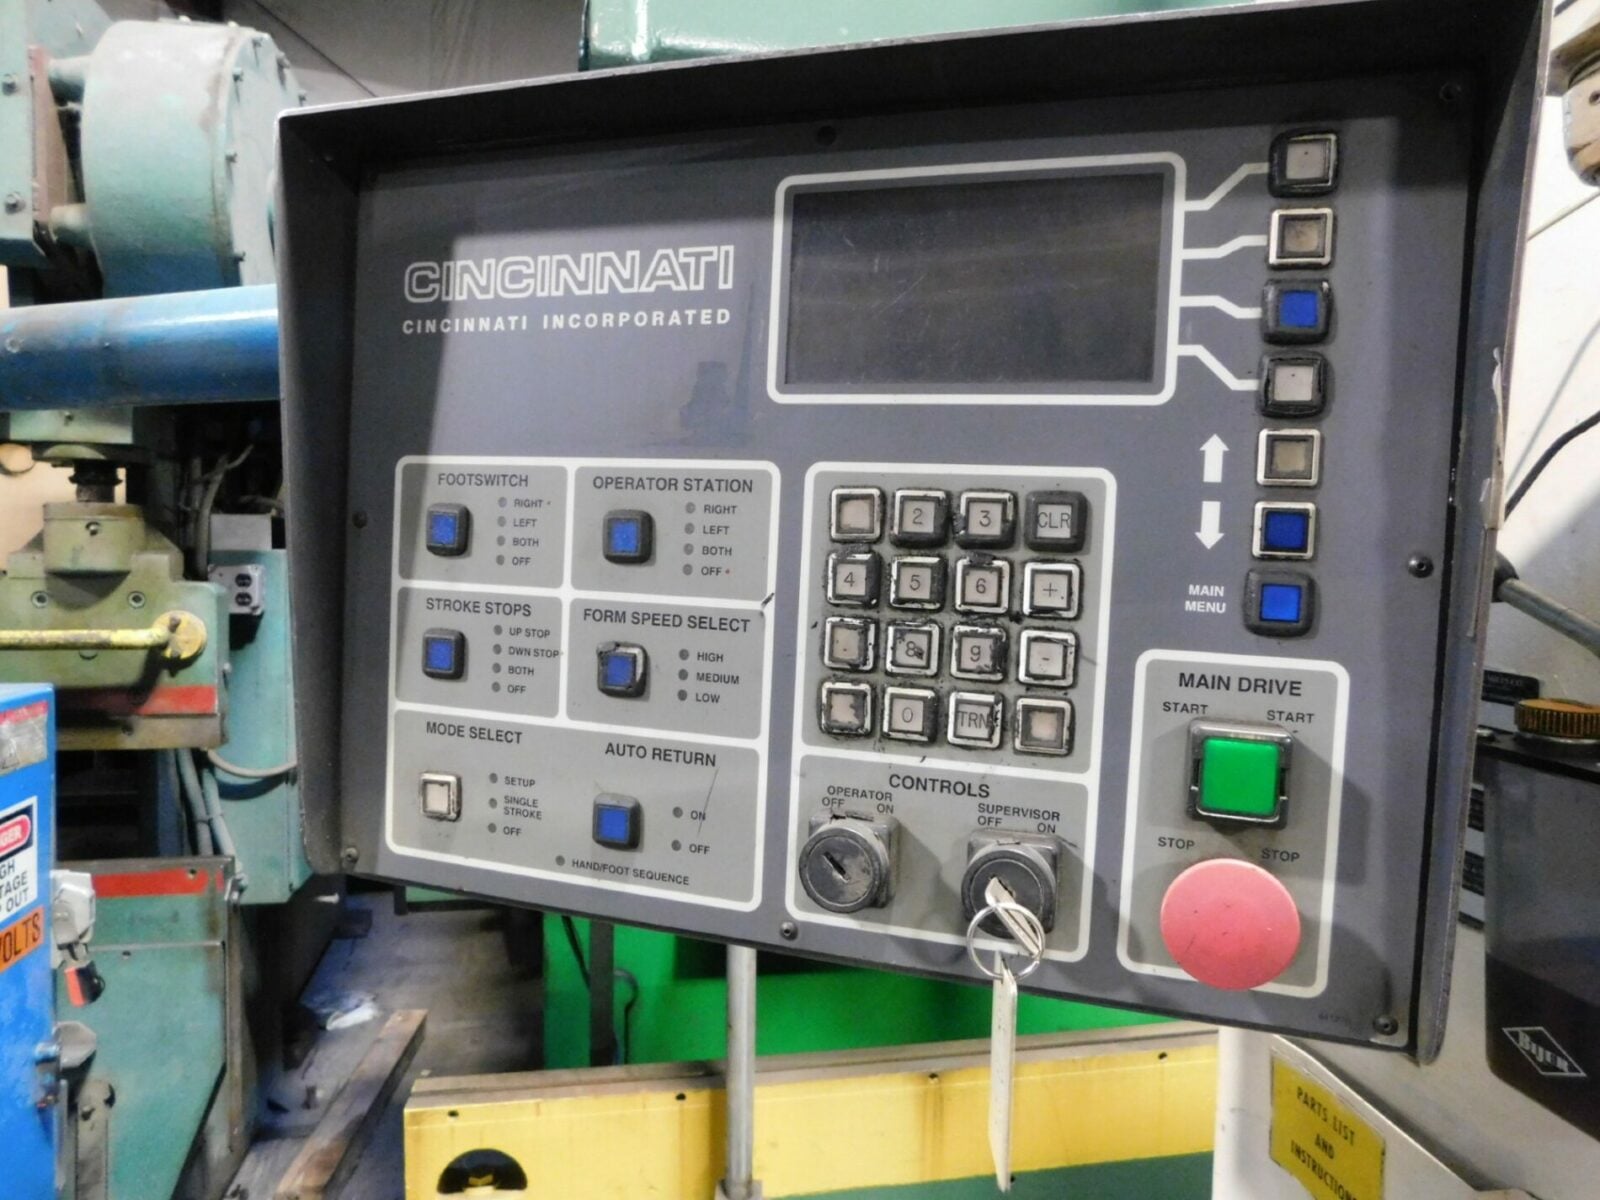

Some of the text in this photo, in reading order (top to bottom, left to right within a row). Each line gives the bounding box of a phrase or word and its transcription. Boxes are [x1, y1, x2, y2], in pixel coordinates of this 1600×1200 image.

[404, 245, 734, 303] CINCINNATI
[402, 308, 731, 334] CINCINNATI INCORPORATED
[437, 473, 529, 487] FOOTSWITCH
[593, 476, 753, 493] OPERATOR STATION
[514, 498, 543, 508] RIGHT
[703, 504, 737, 514] RIGHT
[513, 518, 537, 528] LEFT
[912, 508, 923, 526] 2
[979, 509, 991, 527] 3
[1037, 512, 1071, 529] CLR
[703, 525, 730, 535] LEFT
[512, 537, 539, 547] BOTH
[702, 546, 733, 556] BOTH
[511, 556, 531, 566] OFF
[701, 566, 722, 576] OFF
[843, 571, 855, 588] 4
[909, 574, 921, 592] 5
[975, 578, 987, 594] 6
[1188, 584, 1225, 597] MAIN
[426, 597, 532, 617] STROKE STOPS
[1184, 600, 1226, 613] MENU
[583, 608, 750, 633] FORM SPEED SELECT
[509, 627, 550, 638] UP STOP
[508, 646, 559, 659] DWN STOP
[696, 652, 724, 663] HIGH
[507, 665, 535, 676] BOTH
[696, 672, 740, 685] MEDIUM
[1178, 672, 1302, 697] MAIN DRIVE
[507, 684, 527, 694] OFF
[695, 692, 721, 704] LOW
[1162, 701, 1208, 715] START
[1266, 710, 1314, 724] START
[426, 721, 523, 744] MODE SELECT
[605, 742, 716, 767] AUTO RETURN
[504, 776, 536, 788] SETUP
[889, 773, 990, 798] CONTROLS
[827, 785, 893, 802] OPERATOR
[504, 795, 539, 808] SINGLE
[821, 797, 894, 815] OFF ON
[503, 806, 542, 820] STROKE
[690, 810, 706, 821] ON
[977, 802, 1060, 822] SUPERVISOR
[503, 826, 523, 836] OFF
[977, 815, 1056, 834] OFF ON
[689, 843, 710, 855] OFF
[1158, 836, 1195, 850] STOP
[1262, 848, 1300, 863] STOP
[572, 859, 690, 886] HAND/FOOT SEQUENCE
[1296, 1086, 1355, 1146] PARTS LIST
[1314, 1133, 1335, 1160] AND
[1290, 1140, 1357, 1200] INSTRUCTION
